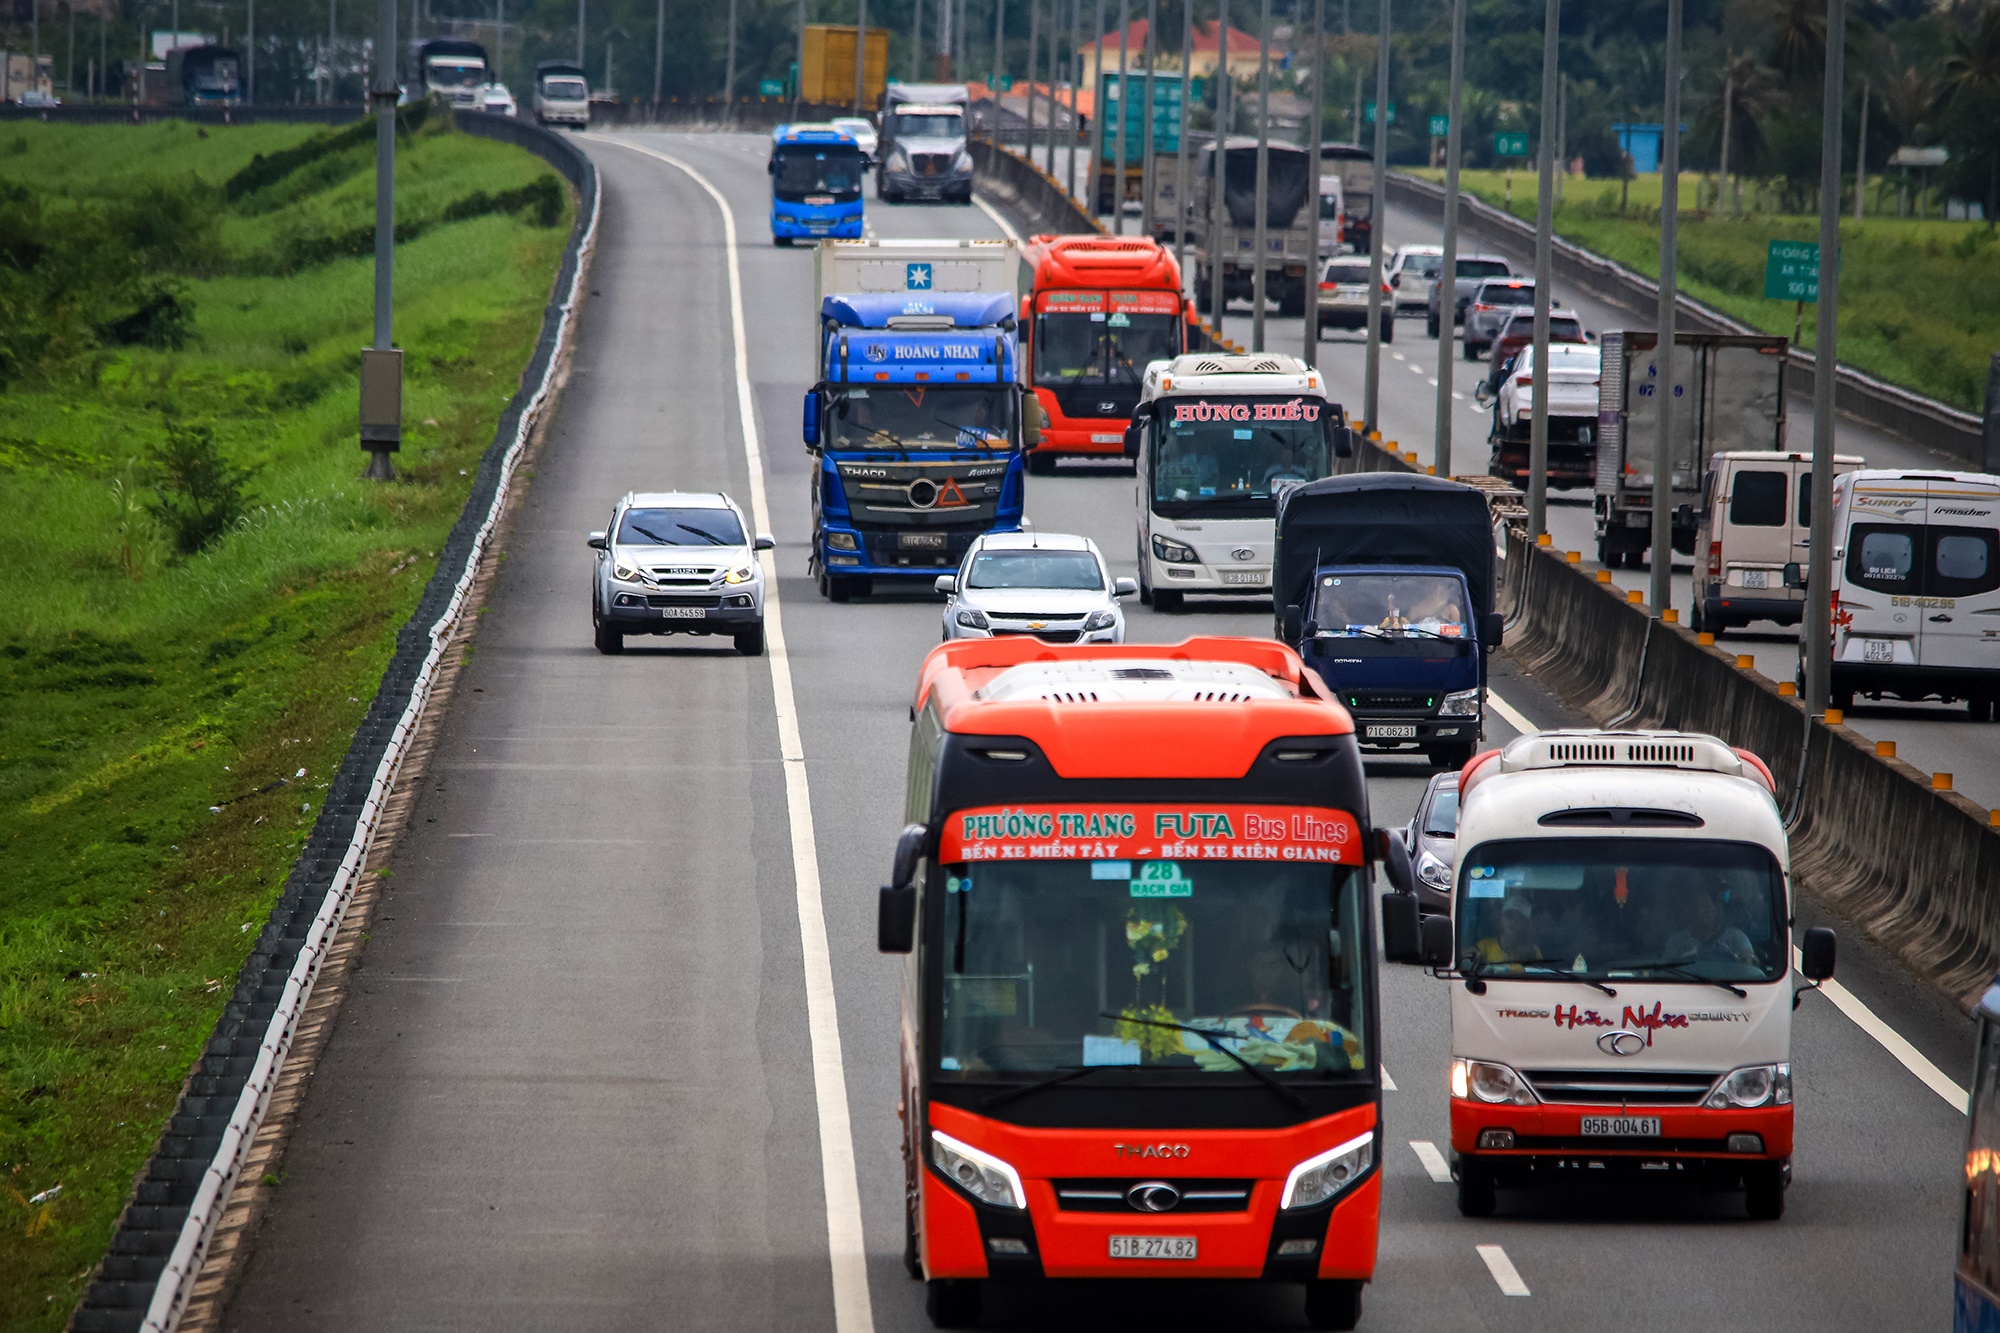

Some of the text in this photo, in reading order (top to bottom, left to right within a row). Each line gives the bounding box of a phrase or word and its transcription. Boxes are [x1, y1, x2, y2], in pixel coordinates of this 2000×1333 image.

[1174, 398, 1320, 422] HÙNG HIẾU
[844, 467, 887, 477] THACO
[670, 567, 699, 575] ISUZU
[1870, 642, 1887, 652] 51B
[963, 809, 1348, 844] PHƯƠNG TRANG FUTA Bus Lines
[962, 840, 1341, 862] BẾN XE MIỀN TÂY BẾN XE KIÊN GIANG
[1147, 862, 1173, 881] 28
[1133, 881, 1190, 897] RẠCH GIÁ
[1496, 1009, 1550, 1019] THACO
[1688, 1012, 1752, 1023] COUNTY
[1583, 1118, 1658, 1135] 95B-004.61
[1113, 1143, 1191, 1159] THACO
[1112, 1239, 1195, 1258] 51B-274.82
